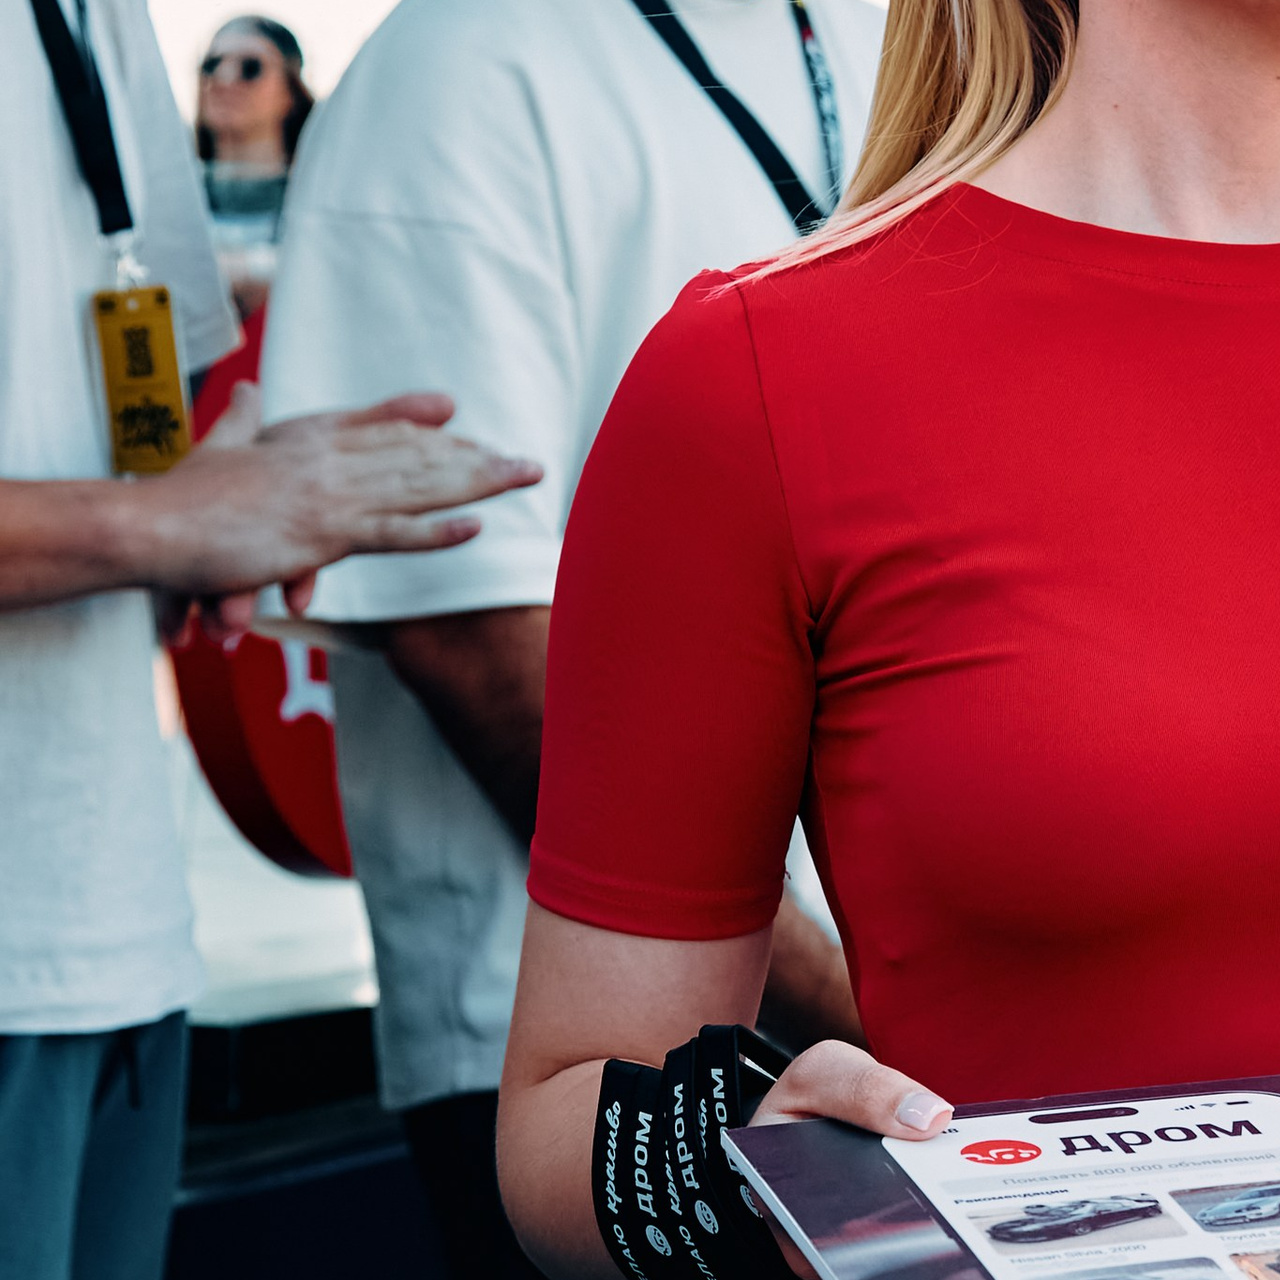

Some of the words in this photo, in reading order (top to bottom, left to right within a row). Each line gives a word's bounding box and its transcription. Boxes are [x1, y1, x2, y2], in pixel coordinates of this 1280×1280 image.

[1058, 1119, 1263, 1155] дром
[605, 1100, 621, 1214] красиво
[1001, 1169, 1089, 1186] Показать
[1130, 1162, 1164, 1173] 000
[953, 1188, 1069, 1205] Рекомендации
